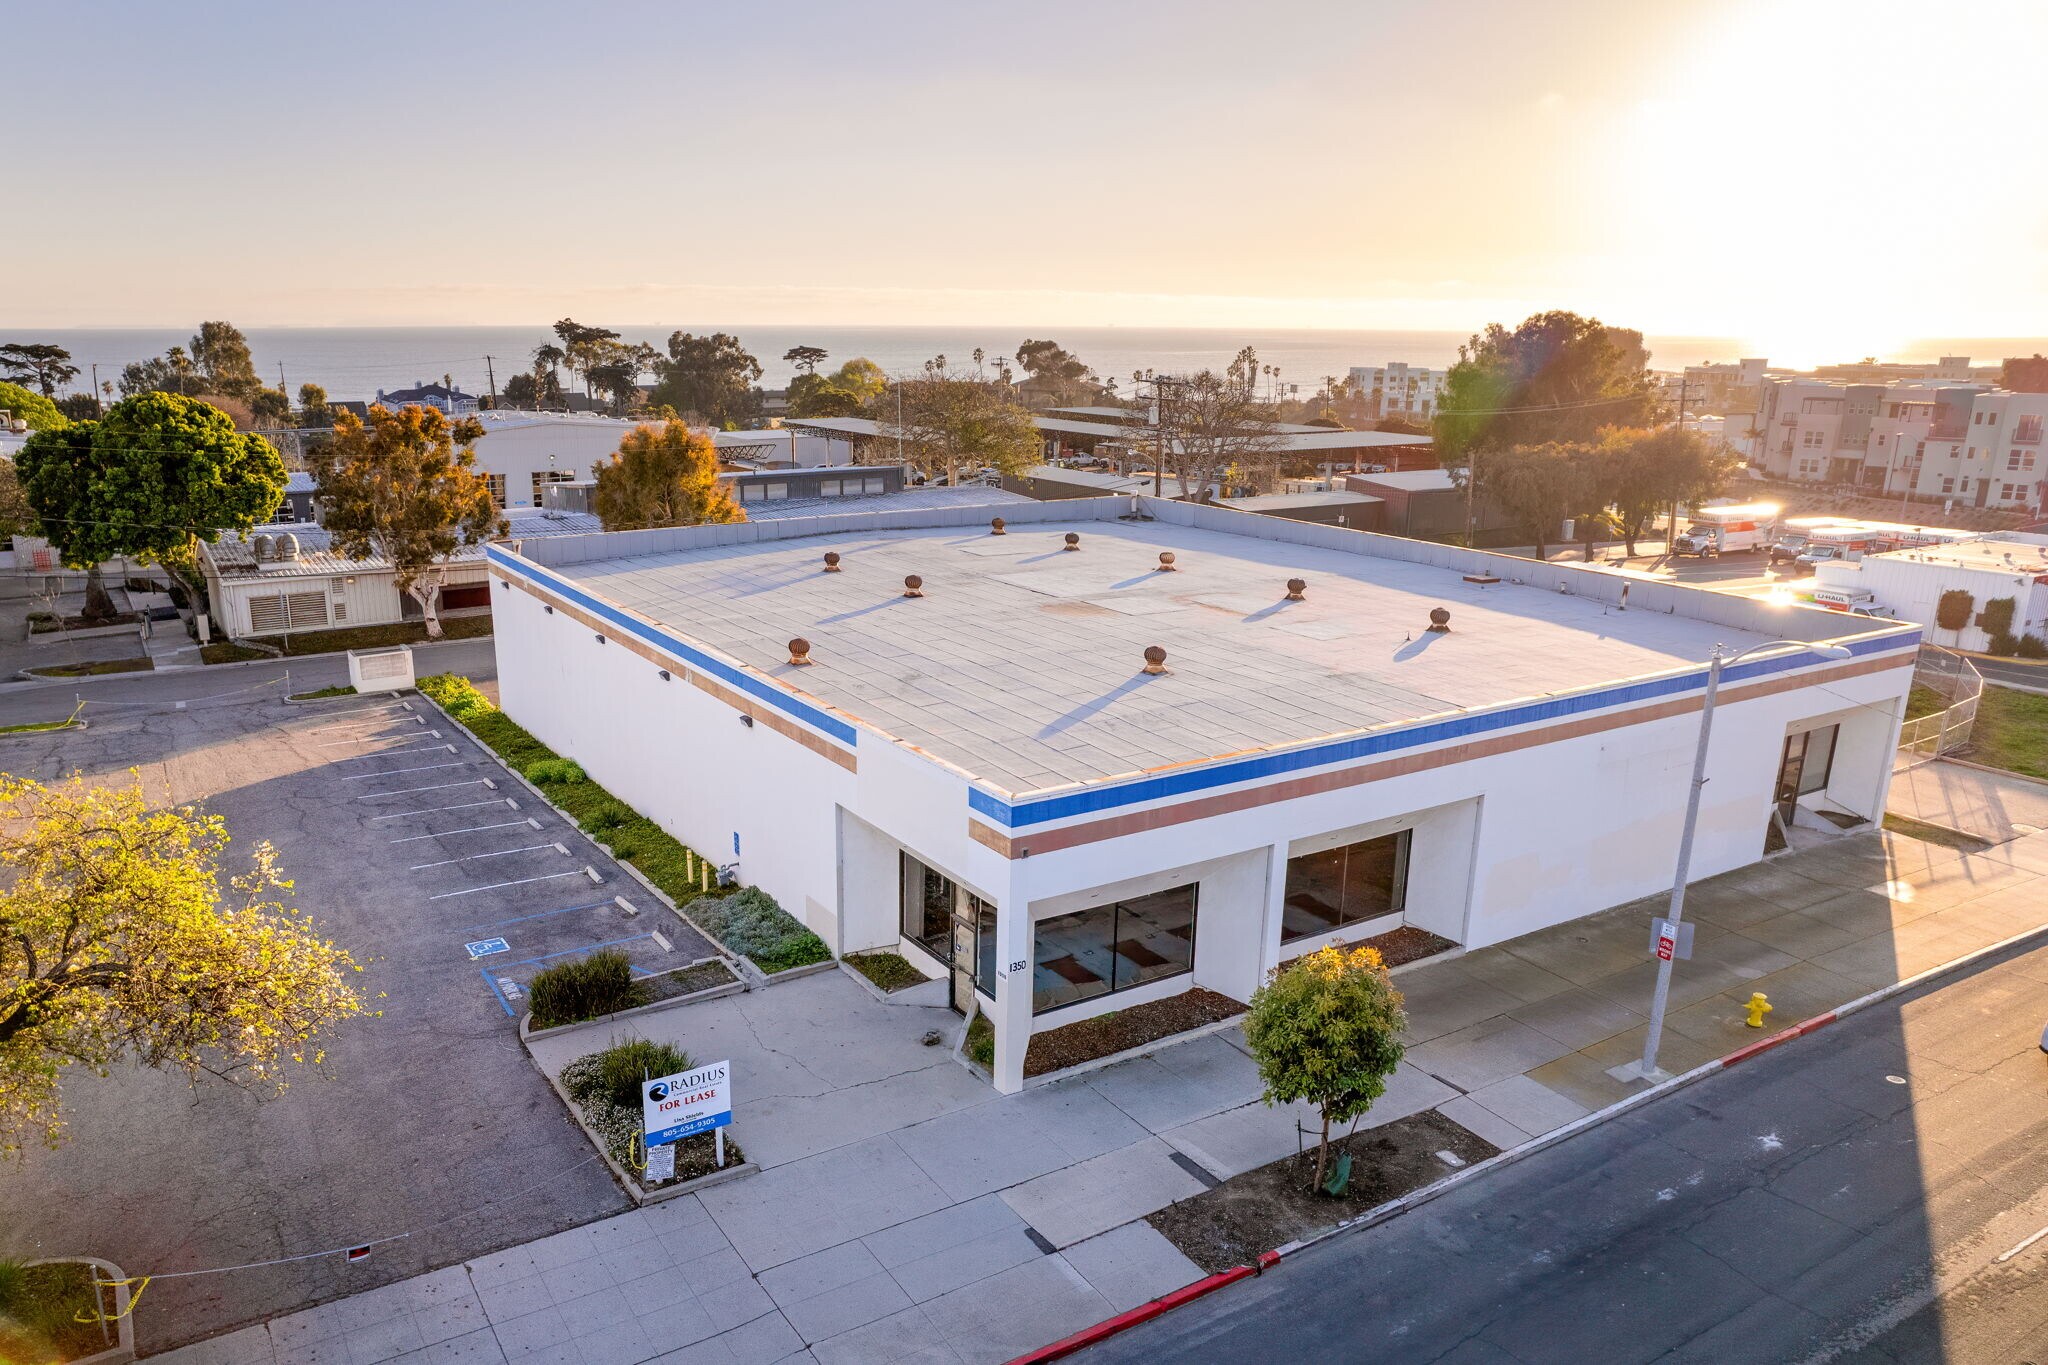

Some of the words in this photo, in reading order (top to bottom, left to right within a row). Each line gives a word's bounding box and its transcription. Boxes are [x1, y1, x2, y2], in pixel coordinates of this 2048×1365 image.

[1817, 593, 1845, 602] U-HAUL
[1009, 960, 1027, 972] 1350
[670, 1067, 725, 1091] RADIUS
[659, 1099, 680, 1112] FOR
[684, 1089, 716, 1104] LEASE
[663, 1118, 716, 1137] 805-654-9305
